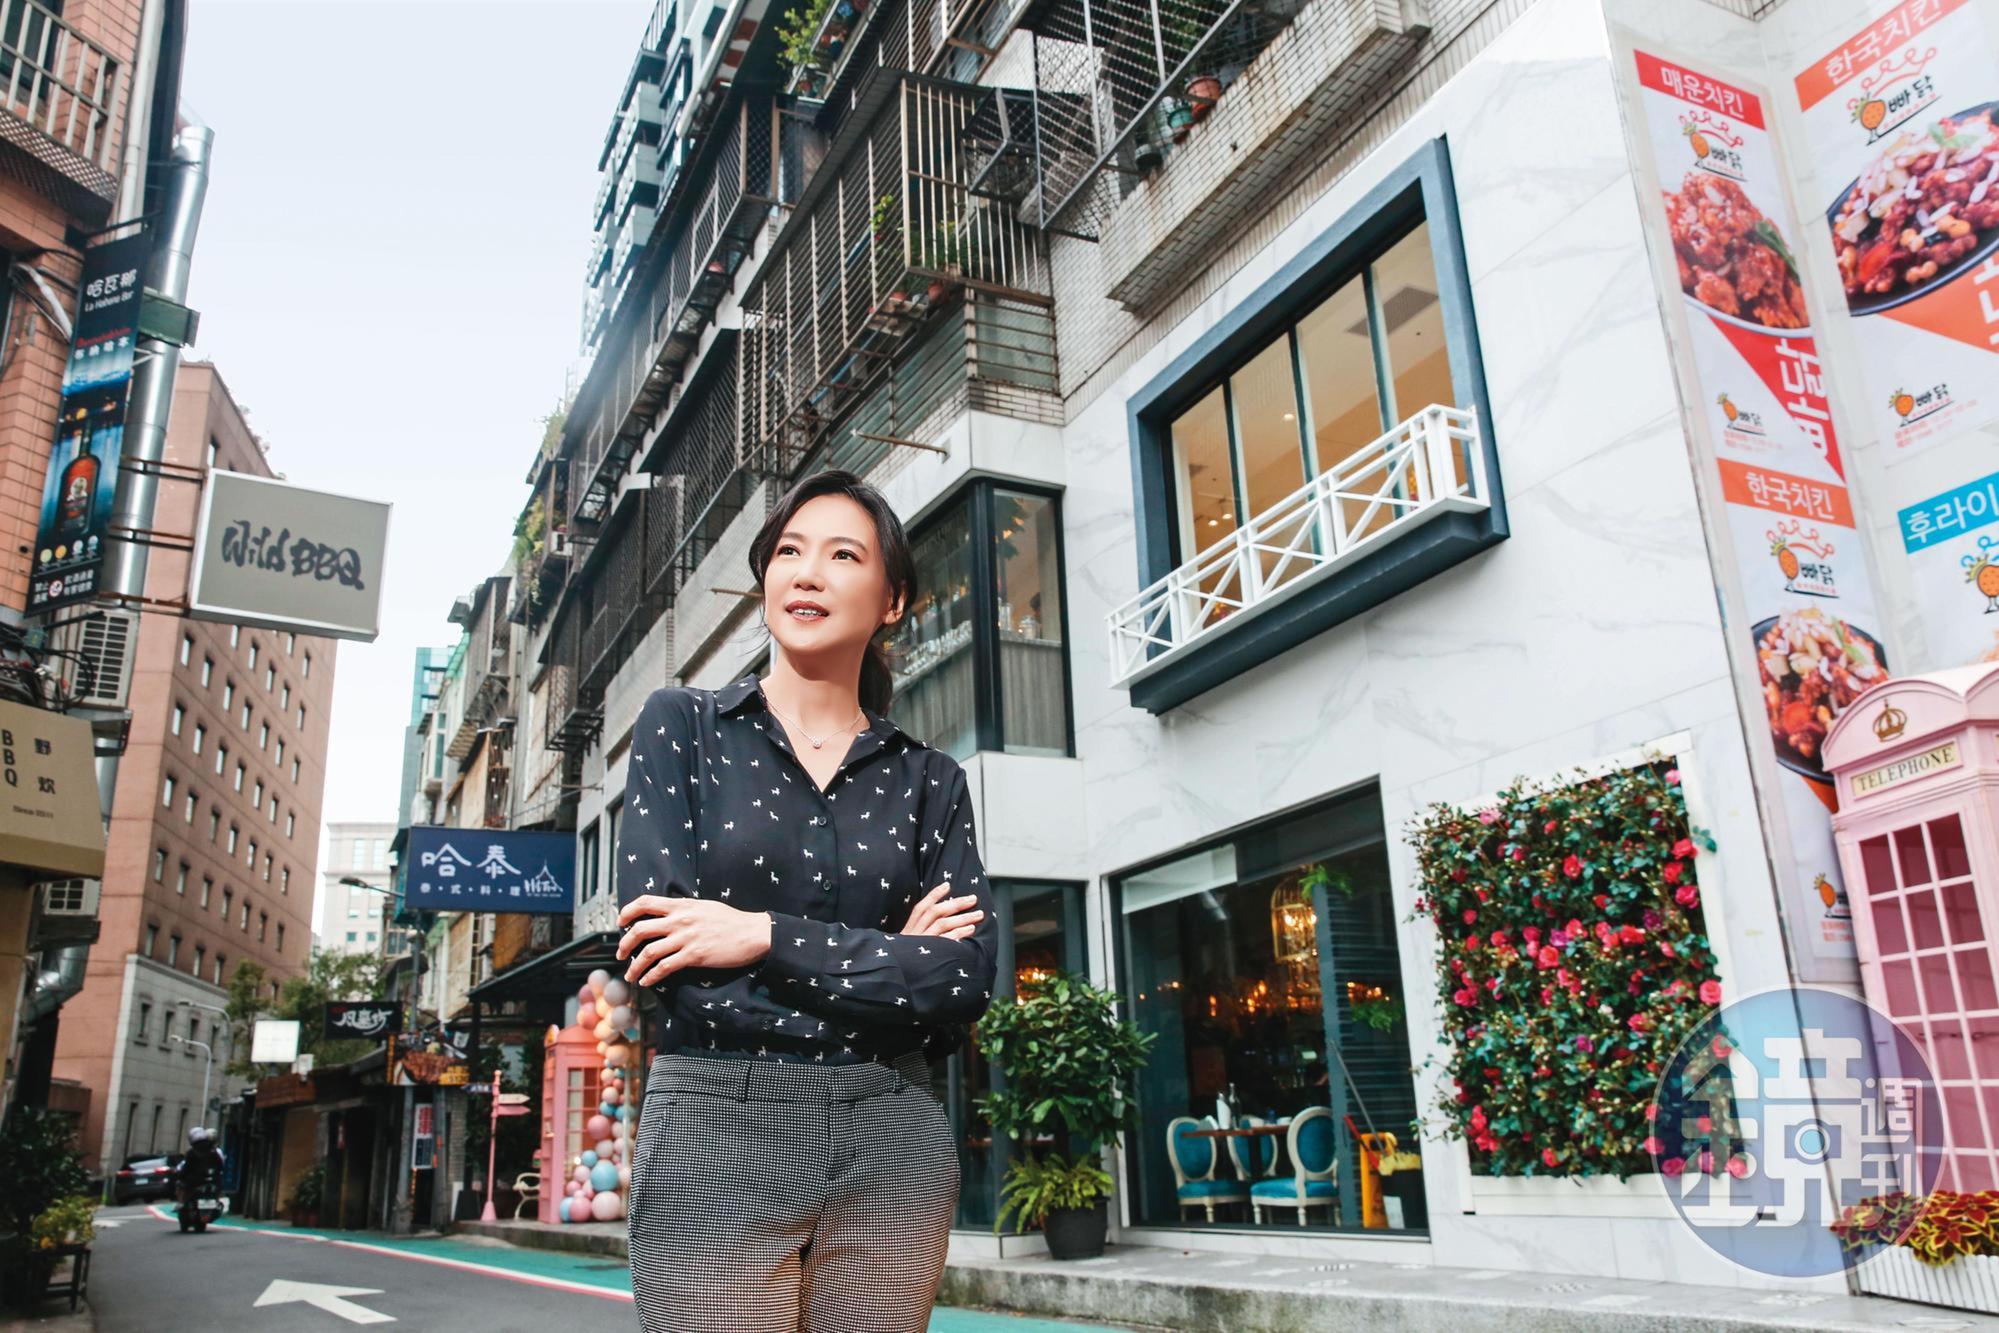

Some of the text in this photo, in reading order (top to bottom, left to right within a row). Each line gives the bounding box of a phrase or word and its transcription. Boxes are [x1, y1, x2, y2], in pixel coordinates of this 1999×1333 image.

[1661, 66, 1745, 120] 매운치킨
[87, 269, 137, 298] 哈瓦那
[1746, 472, 1834, 520] 한국치킨
[221, 519, 364, 591] Wild BBQ
[2, 729, 18, 788] BBQ
[1859, 746, 1955, 791] TELEPHONE
[421, 843, 522, 880] 哈泰
